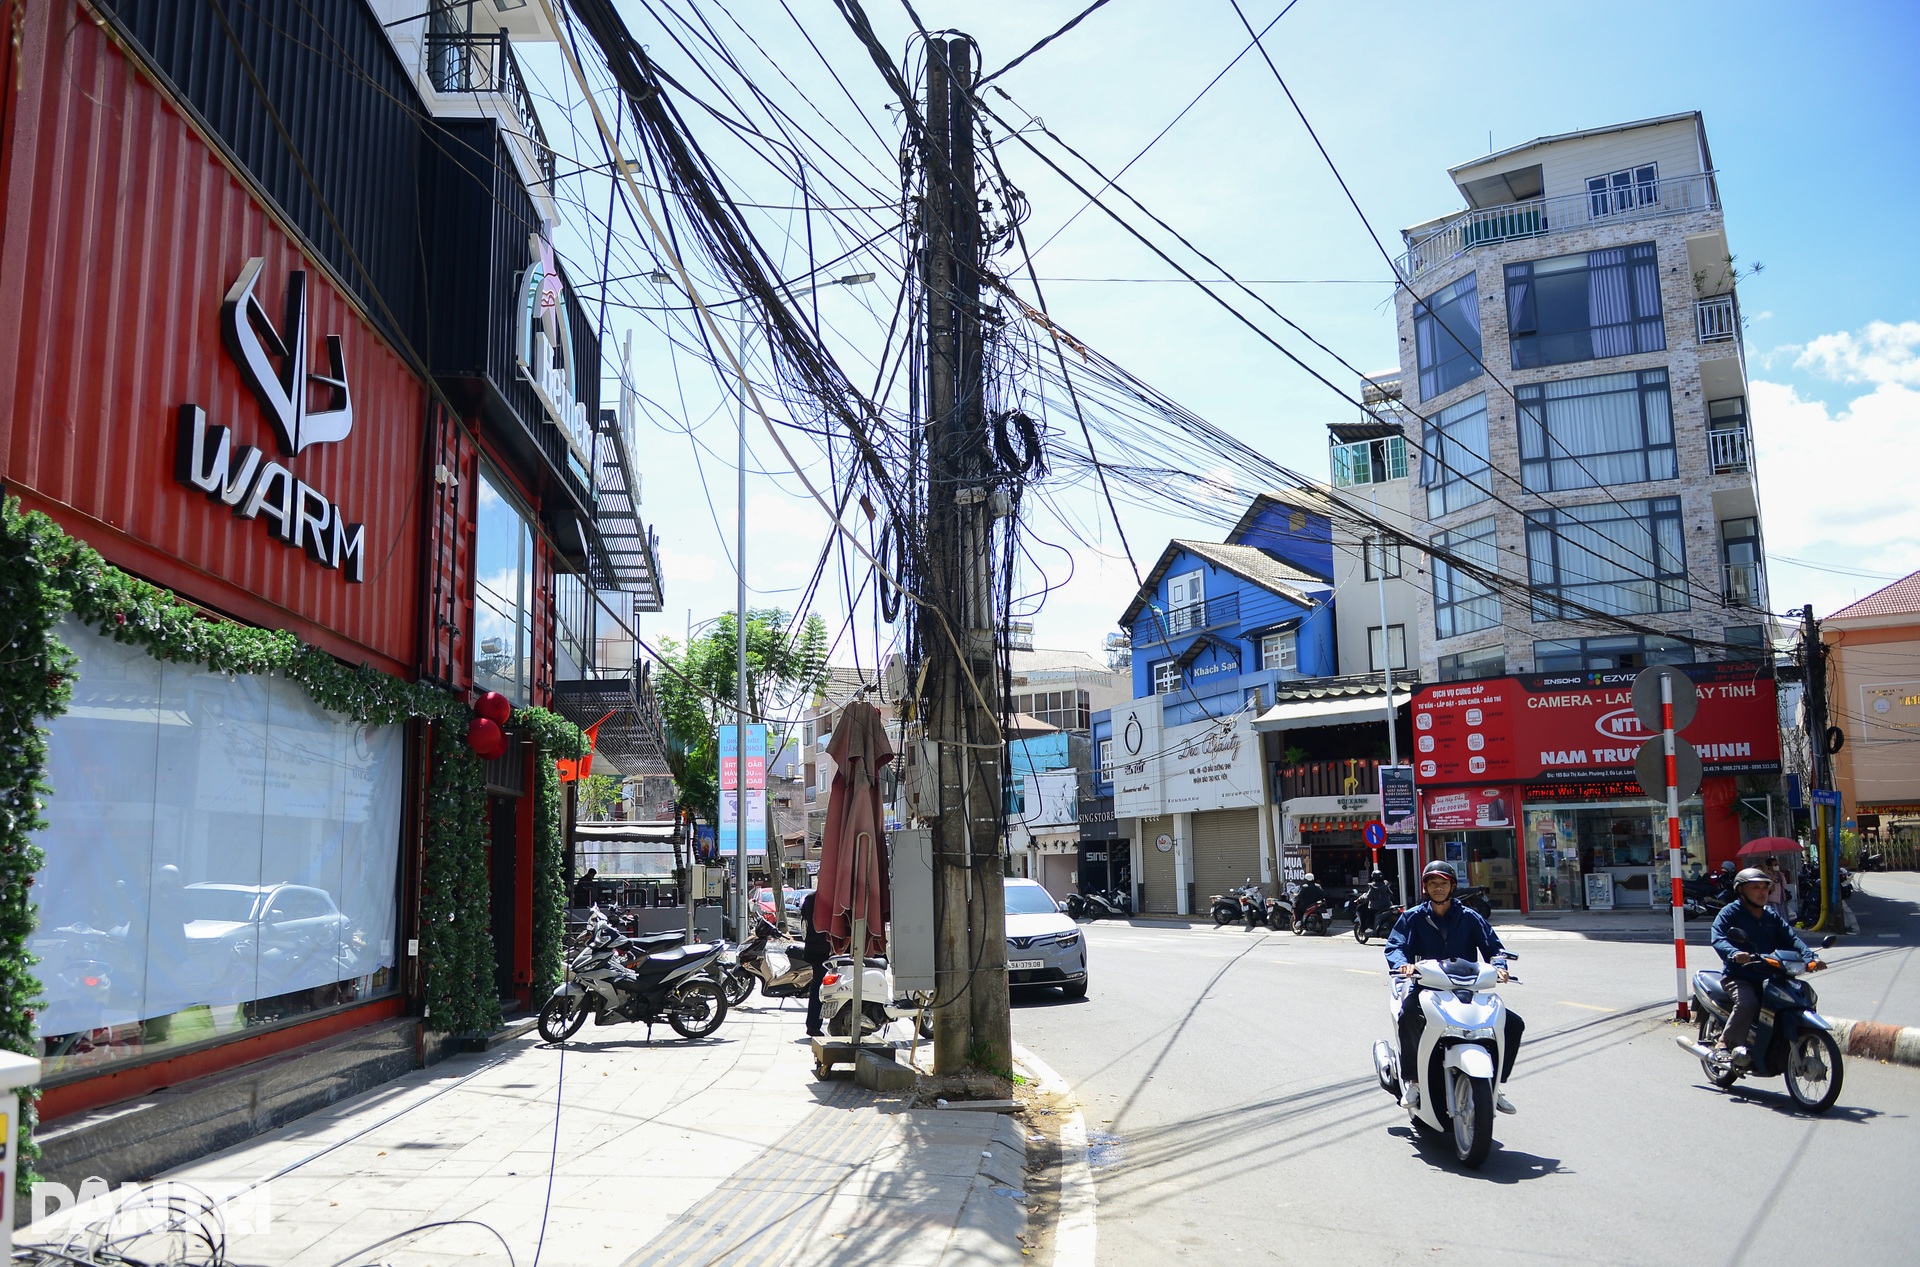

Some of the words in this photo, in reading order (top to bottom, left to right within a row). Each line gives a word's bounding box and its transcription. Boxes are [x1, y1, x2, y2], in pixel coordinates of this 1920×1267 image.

[178, 404, 365, 583] WARM
[1194, 665, 1219, 677] Khách
[1221, 662, 1237, 672] Sạn
[1456, 688, 1471, 696] CUNG
[1696, 685, 1715, 699] ÁY
[1719, 684, 1756, 698] TÍNH
[1527, 695, 1592, 709] CAMERA
[1541, 750, 1587, 765] NAM
[1079, 812, 1114, 824] SINGSTORE
[1284, 857, 1302, 868] MUA
[1284, 867, 1304, 881] TẶNG
